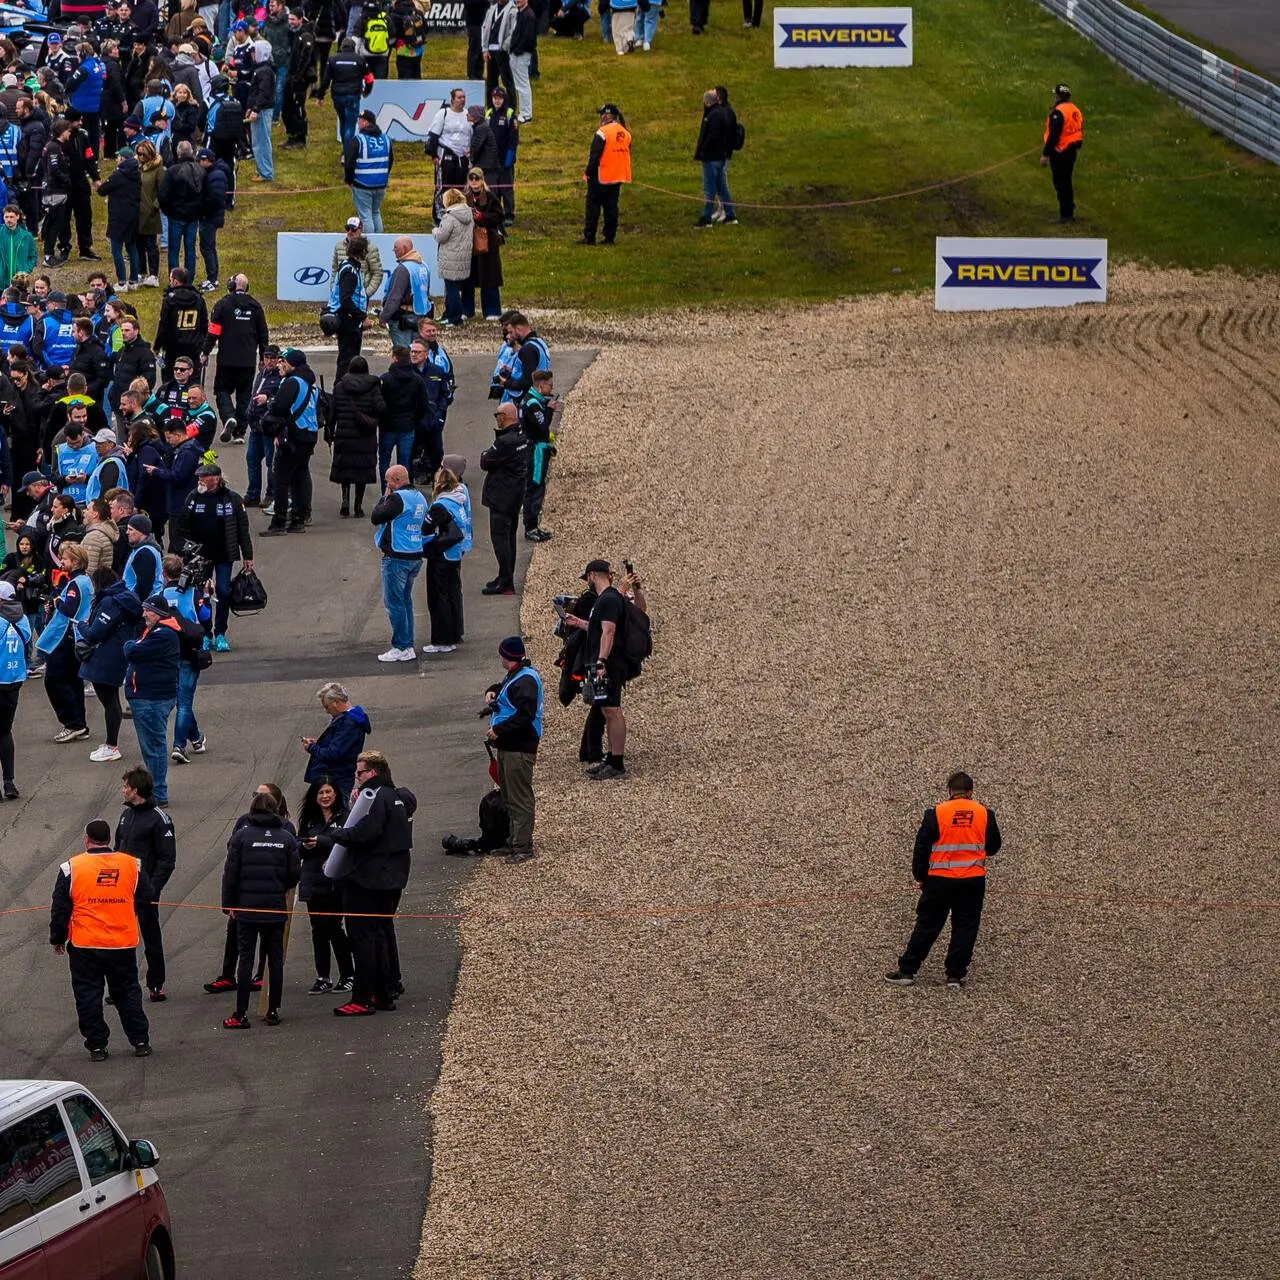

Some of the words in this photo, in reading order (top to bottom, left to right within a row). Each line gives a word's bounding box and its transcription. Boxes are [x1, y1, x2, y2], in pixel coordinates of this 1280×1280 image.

[791, 28, 896, 43] RAVENOL
[958, 264, 1087, 282] RAVENOL
[177, 309, 197, 329] 10
[6, 639, 19, 653] TV
